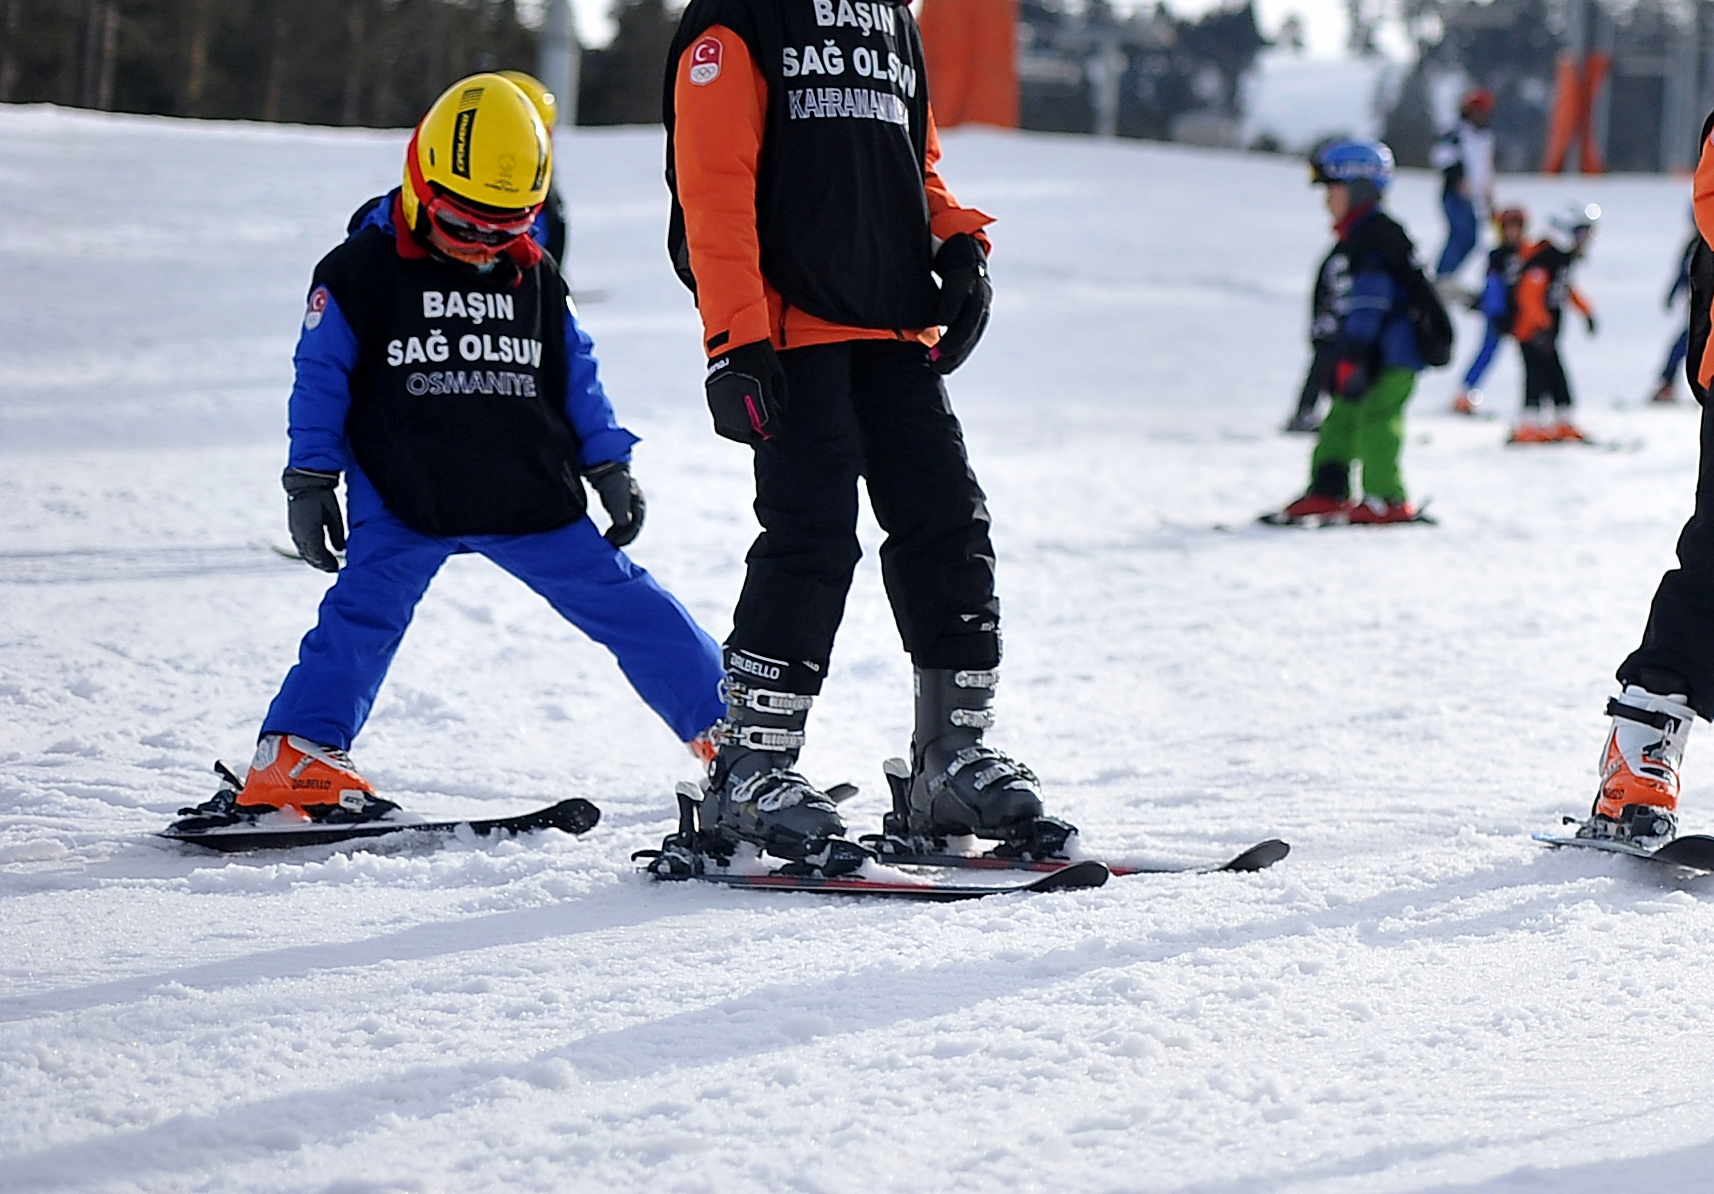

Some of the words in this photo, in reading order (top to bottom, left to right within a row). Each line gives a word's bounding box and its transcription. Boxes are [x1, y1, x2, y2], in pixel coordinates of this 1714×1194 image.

[782, 38, 845, 78] SAĞ
[422, 290, 515, 325] BAŞIN
[386, 328, 450, 367] SAĞ
[458, 334, 543, 369] OLSUN
